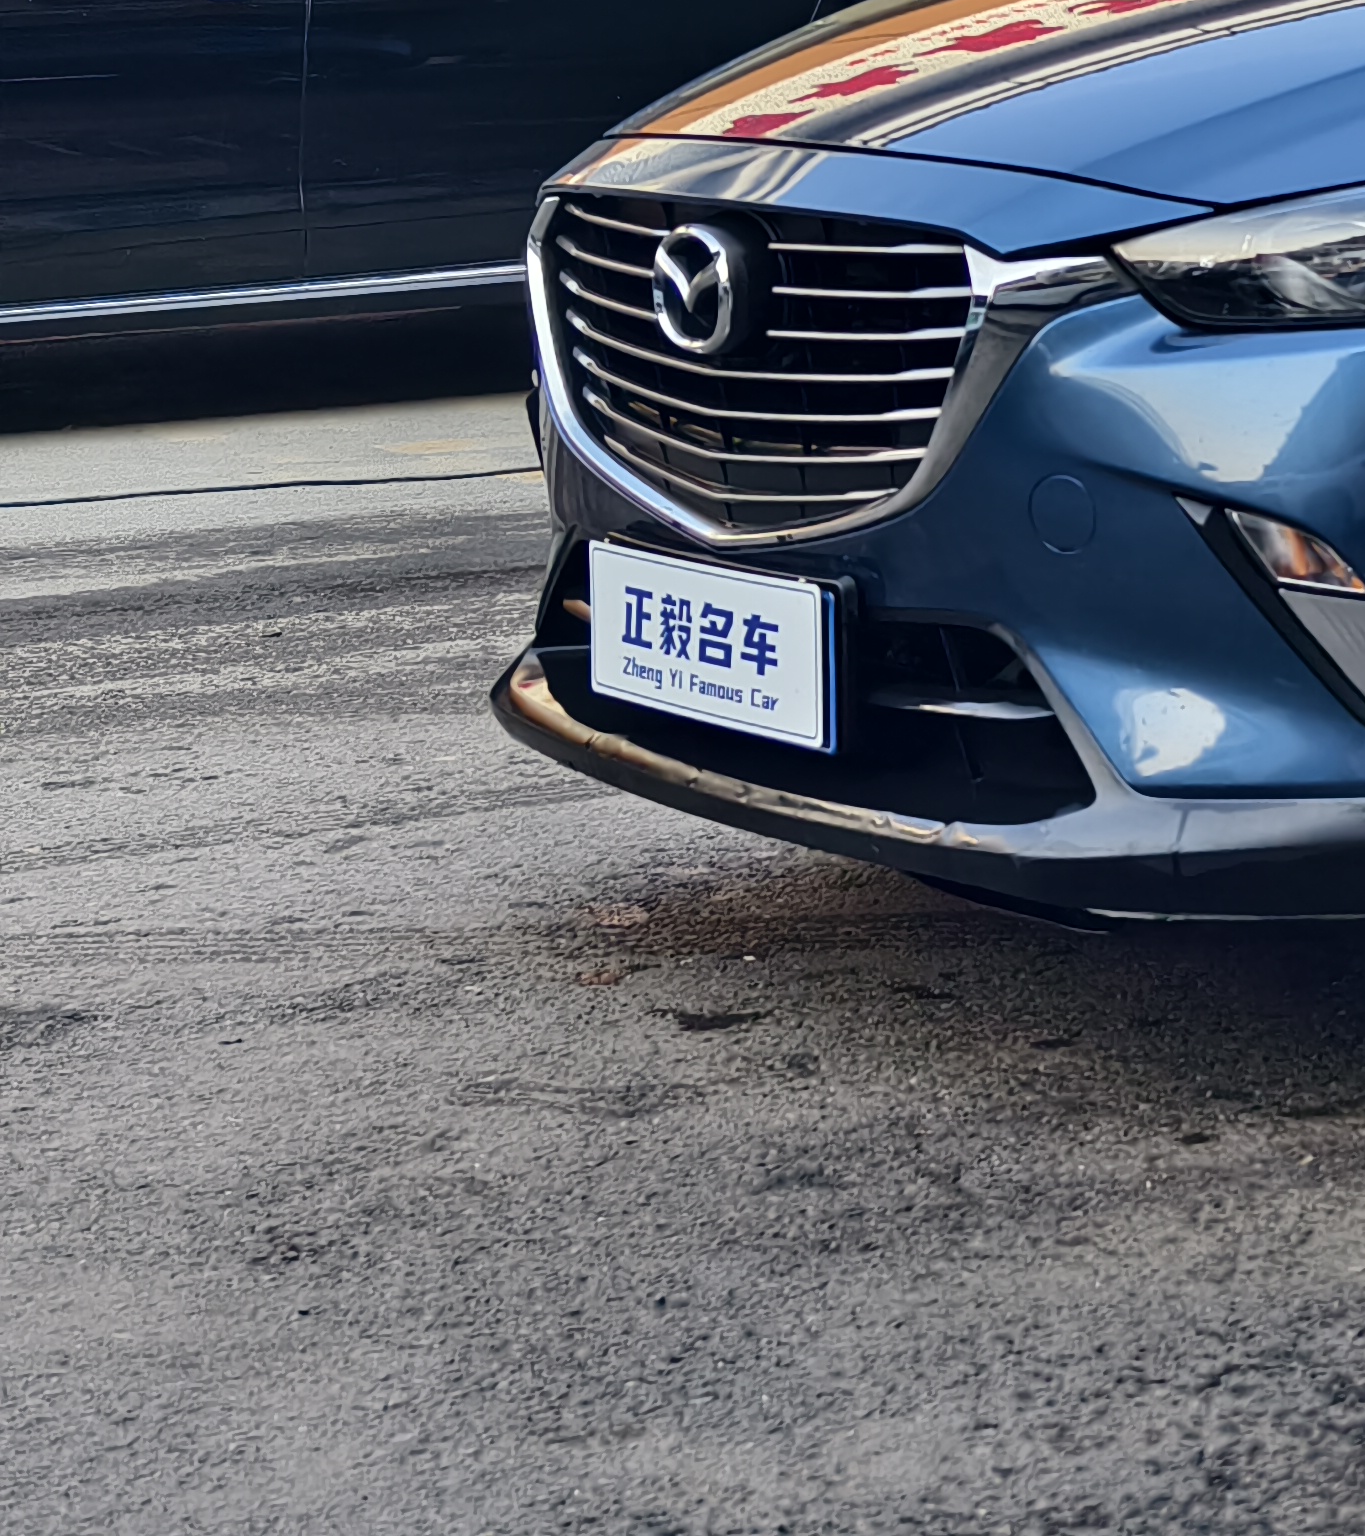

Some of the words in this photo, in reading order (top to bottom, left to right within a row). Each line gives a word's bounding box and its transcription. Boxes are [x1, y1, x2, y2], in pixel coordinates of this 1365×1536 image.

[621, 585, 779, 676] 正毅名车
[622, 655, 663, 690] Zheng
[689, 672, 743, 703] Famous
[750, 687, 779, 711] Car
